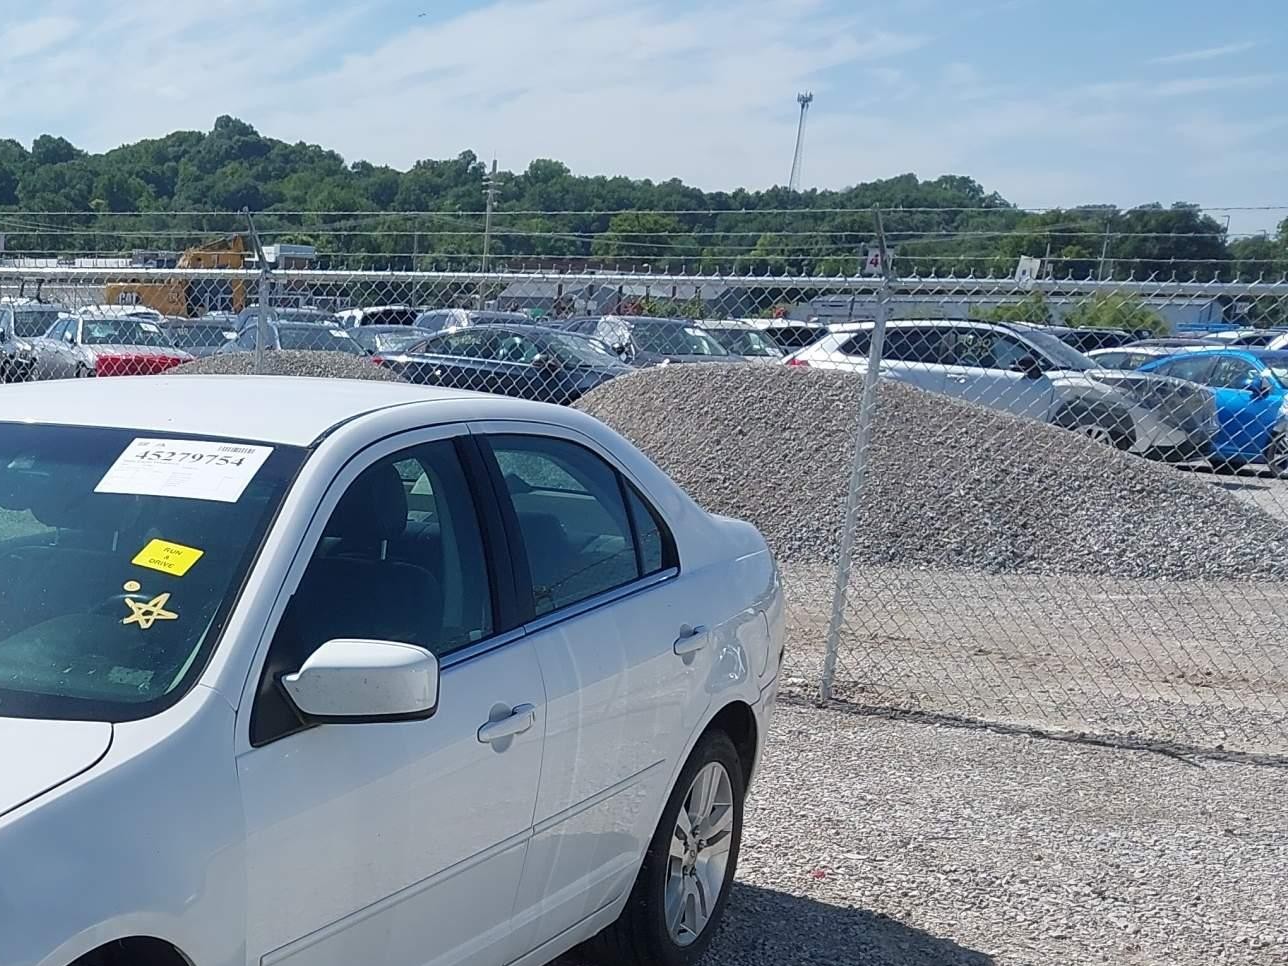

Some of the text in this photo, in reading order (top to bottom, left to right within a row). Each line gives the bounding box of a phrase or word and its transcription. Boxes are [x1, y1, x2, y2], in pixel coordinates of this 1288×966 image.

[869, 254, 879, 267] 4
[135, 450, 246, 467] 45279754
[163, 547, 183, 556] RUN
[148, 558, 175, 569] DRIVE
